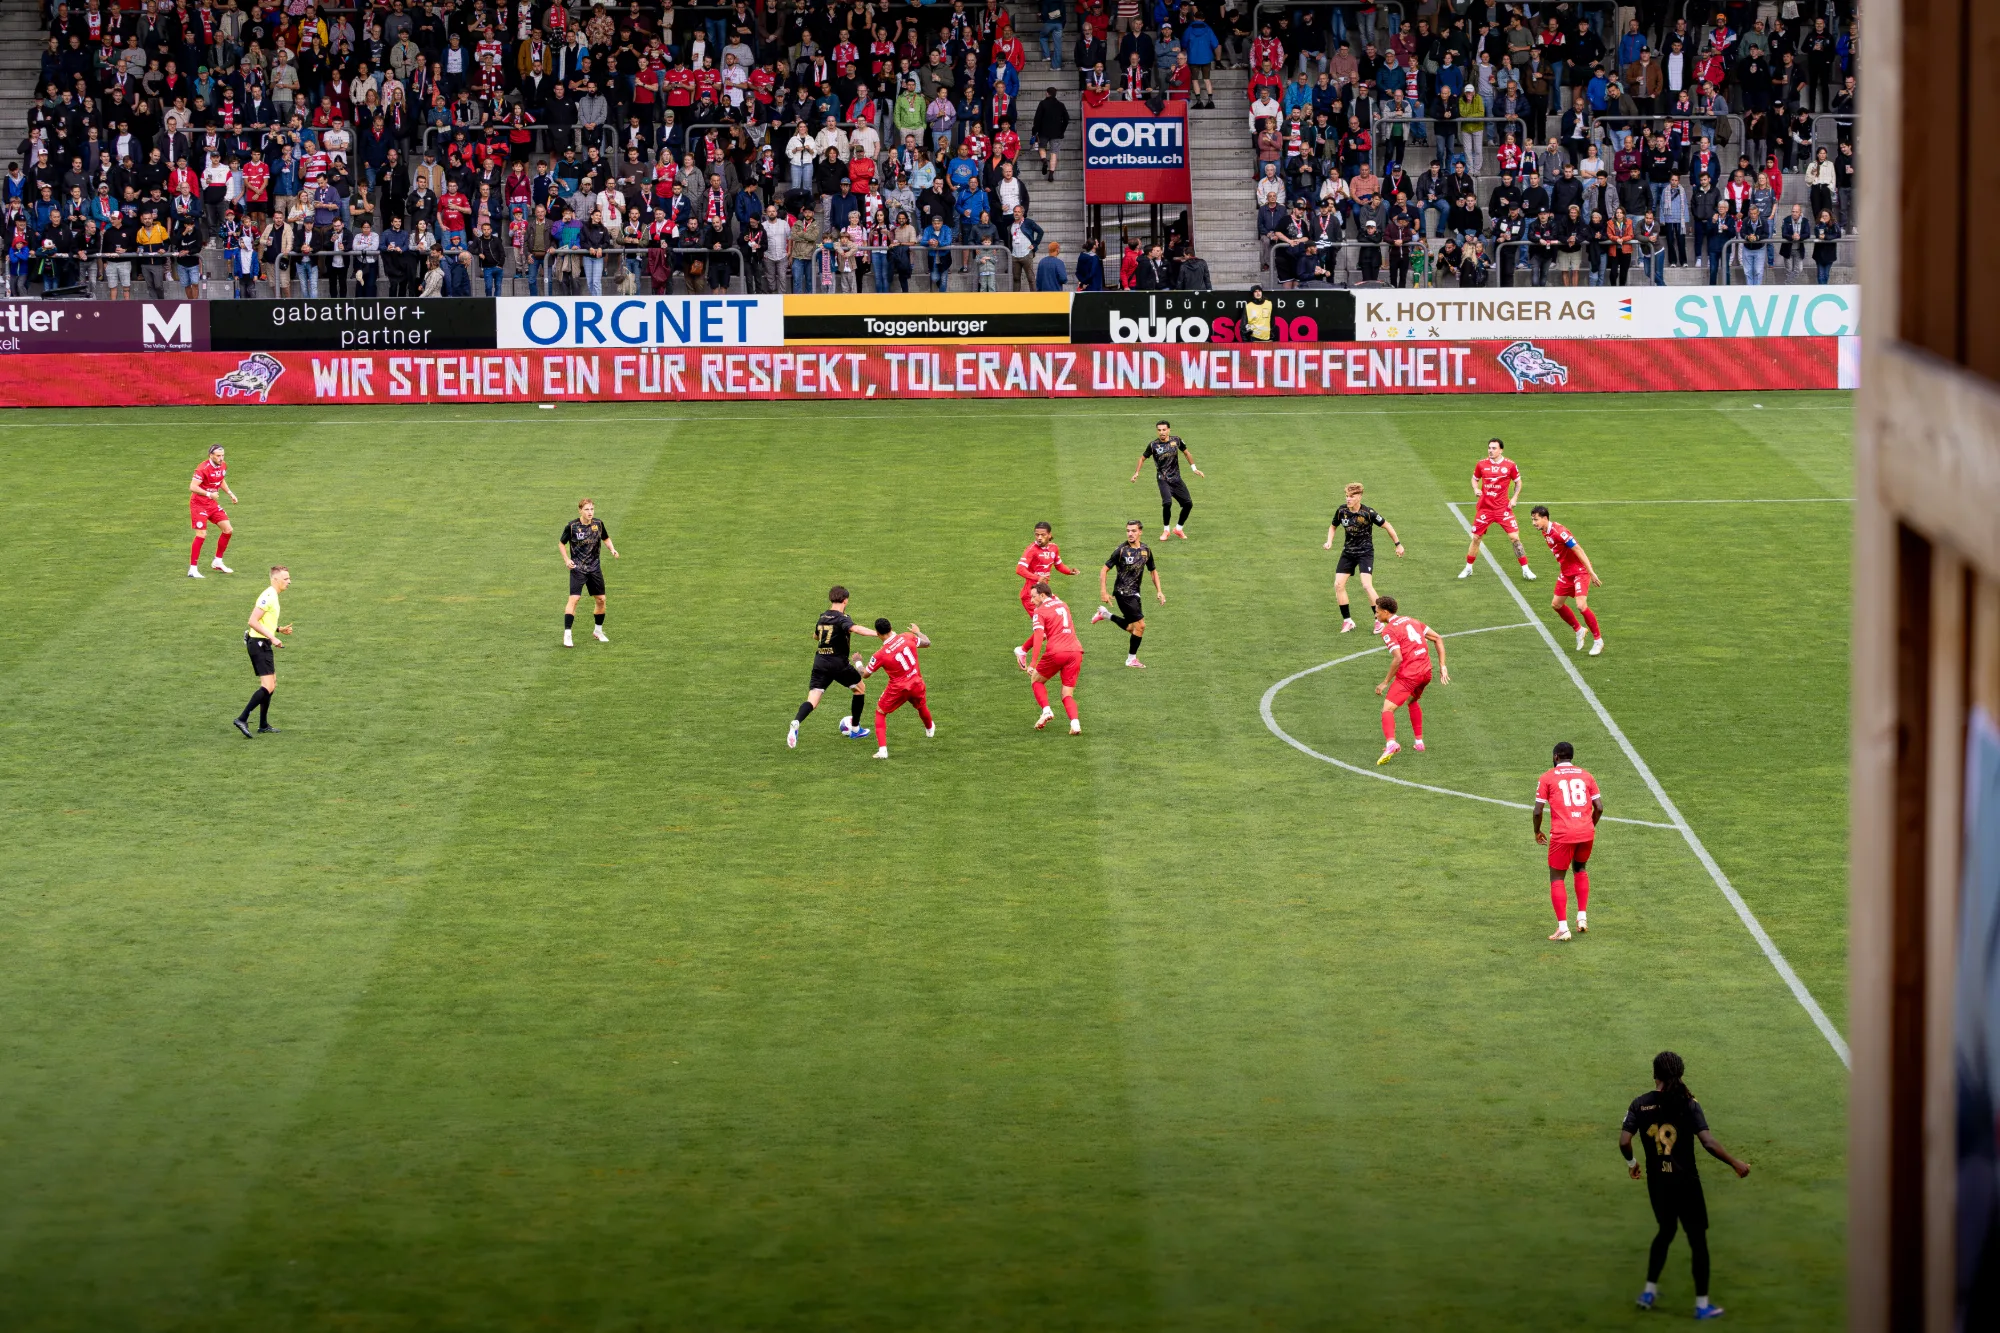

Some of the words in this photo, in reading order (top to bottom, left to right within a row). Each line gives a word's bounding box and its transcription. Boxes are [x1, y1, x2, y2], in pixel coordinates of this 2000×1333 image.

[1088, 122, 1183, 148] CORTI
[1088, 153, 1183, 165] cortibau.ch
[1166, 297, 1319, 310] Bürombel
[1366, 302, 1391, 323] K.
[1397, 300, 1552, 322] HOTTINGER
[1557, 300, 1596, 321] AG
[1672, 293, 1860, 337] SWIC
[142, 303, 193, 344] M
[521, 299, 759, 346] ORGNET
[863, 317, 988, 336] Toggenburger
[341, 327, 432, 347] partner
[311, 357, 375, 398] WIR
[388, 356, 529, 396] STEHEN
[543, 355, 600, 395] EIN
[613, 347, 686, 394] FÜR
[701, 353, 877, 398] RESPEKT,
[884, 351, 1078, 392] TOLERANZ
[1092, 350, 1167, 390] UND
[1180, 347, 1477, 390] WELTOFFENHEIT.
[1055, 607, 1069, 628] 7
[817, 624, 834, 644] 17
[1405, 624, 1423, 645] 4
[895, 646, 917, 672] 11
[1558, 778, 1588, 807] 18
[1646, 1123, 1678, 1156] 19
